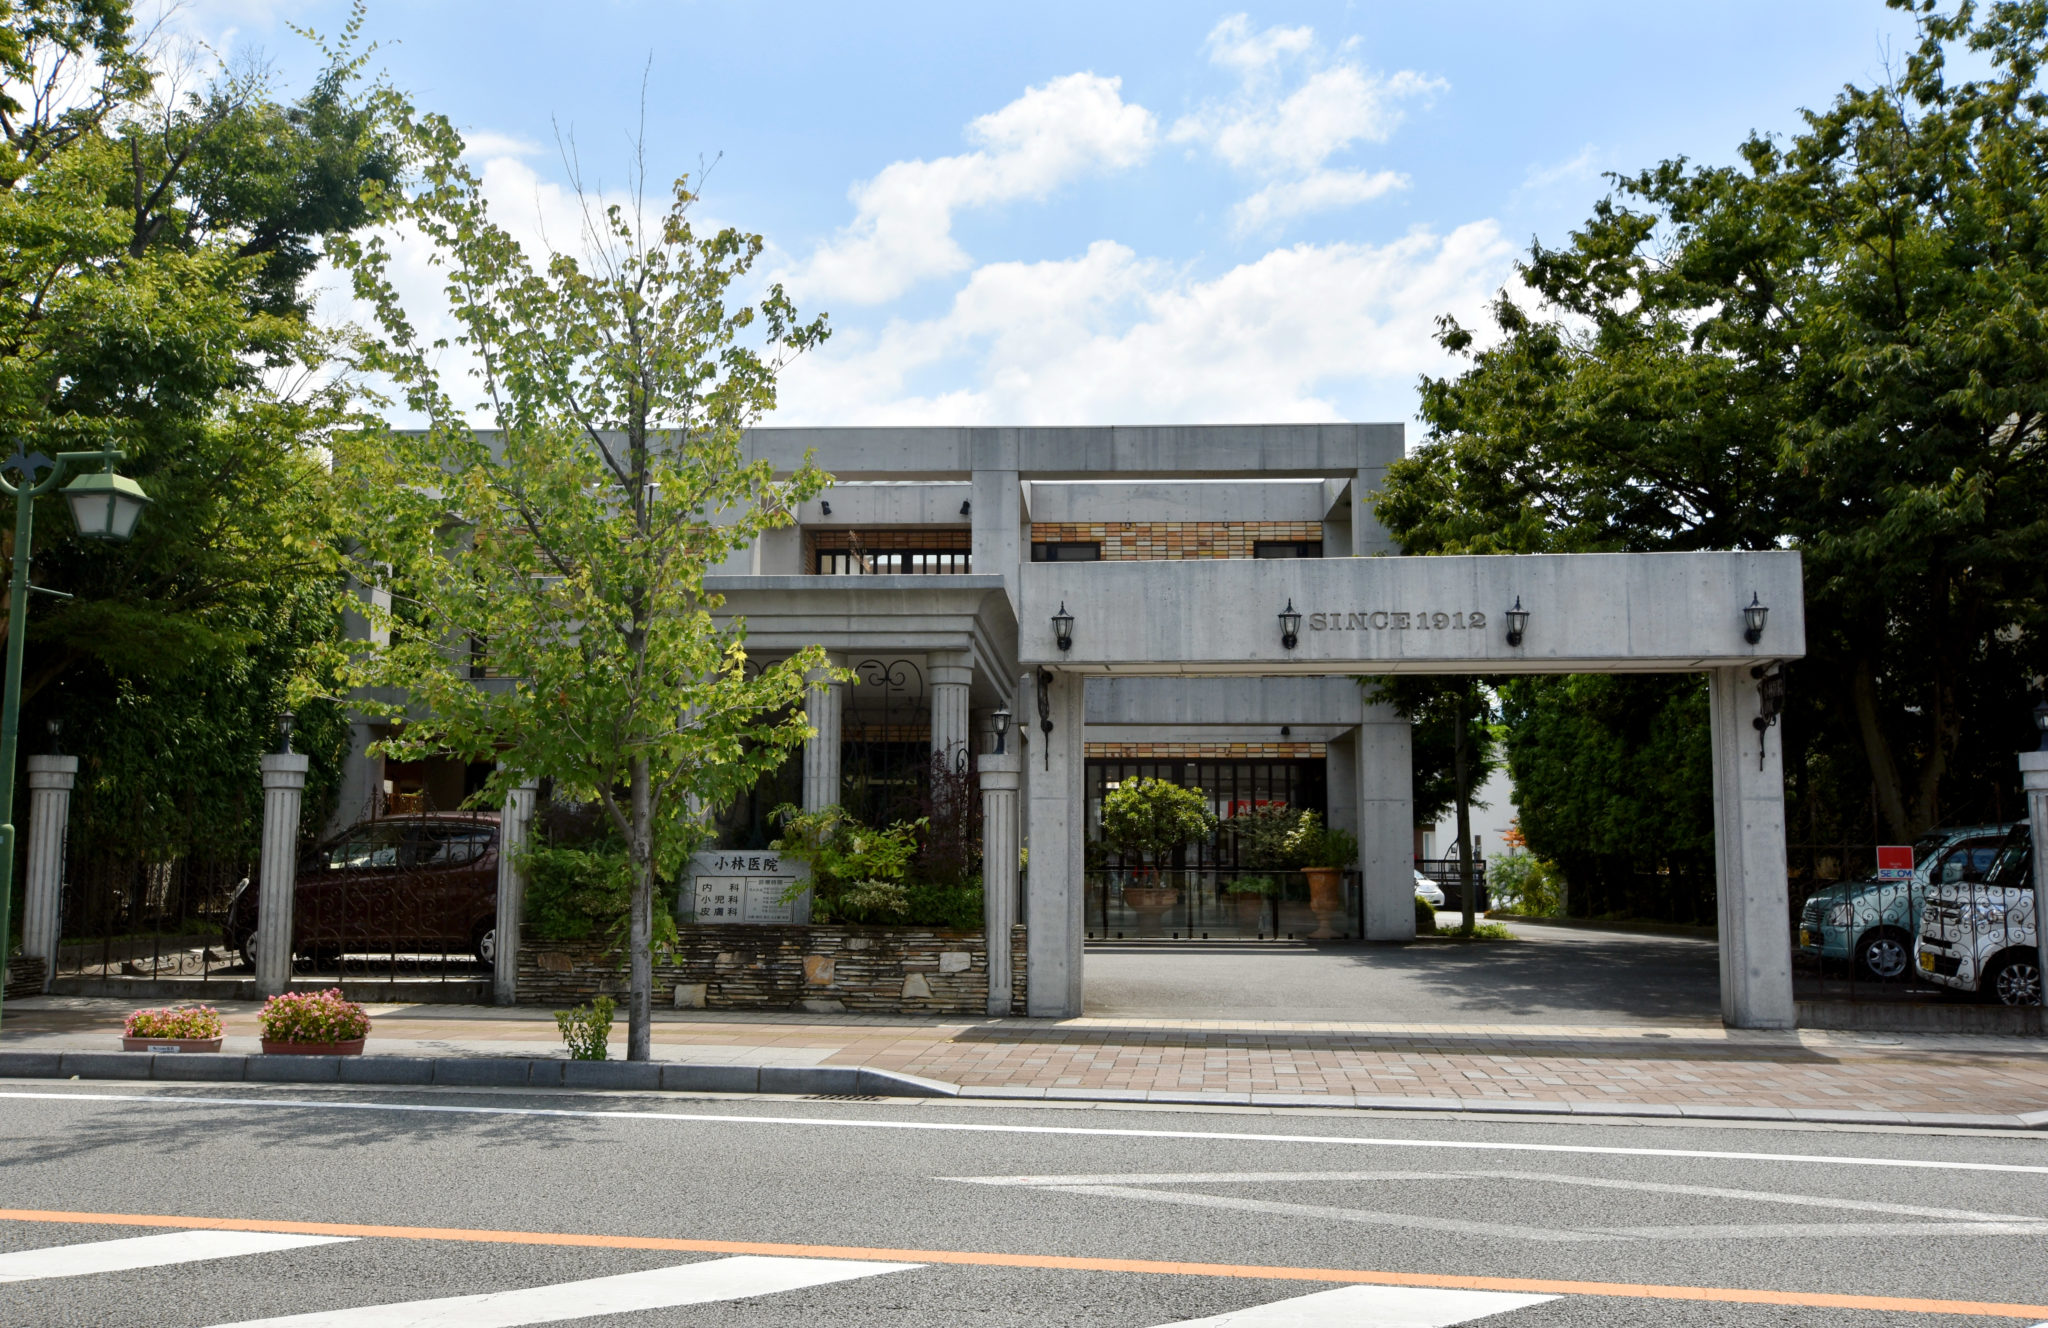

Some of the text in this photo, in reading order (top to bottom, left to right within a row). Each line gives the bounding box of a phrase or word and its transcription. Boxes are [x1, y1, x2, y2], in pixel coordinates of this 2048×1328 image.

[1309, 611, 1487, 631] SINCE 1912
[714, 856, 779, 872] 小林医院
[1880, 869, 1912, 878] SECOM
[702, 883, 740, 893] 内科
[701, 895, 738, 905] 小児科
[700, 907, 738, 917] 皮膚科
